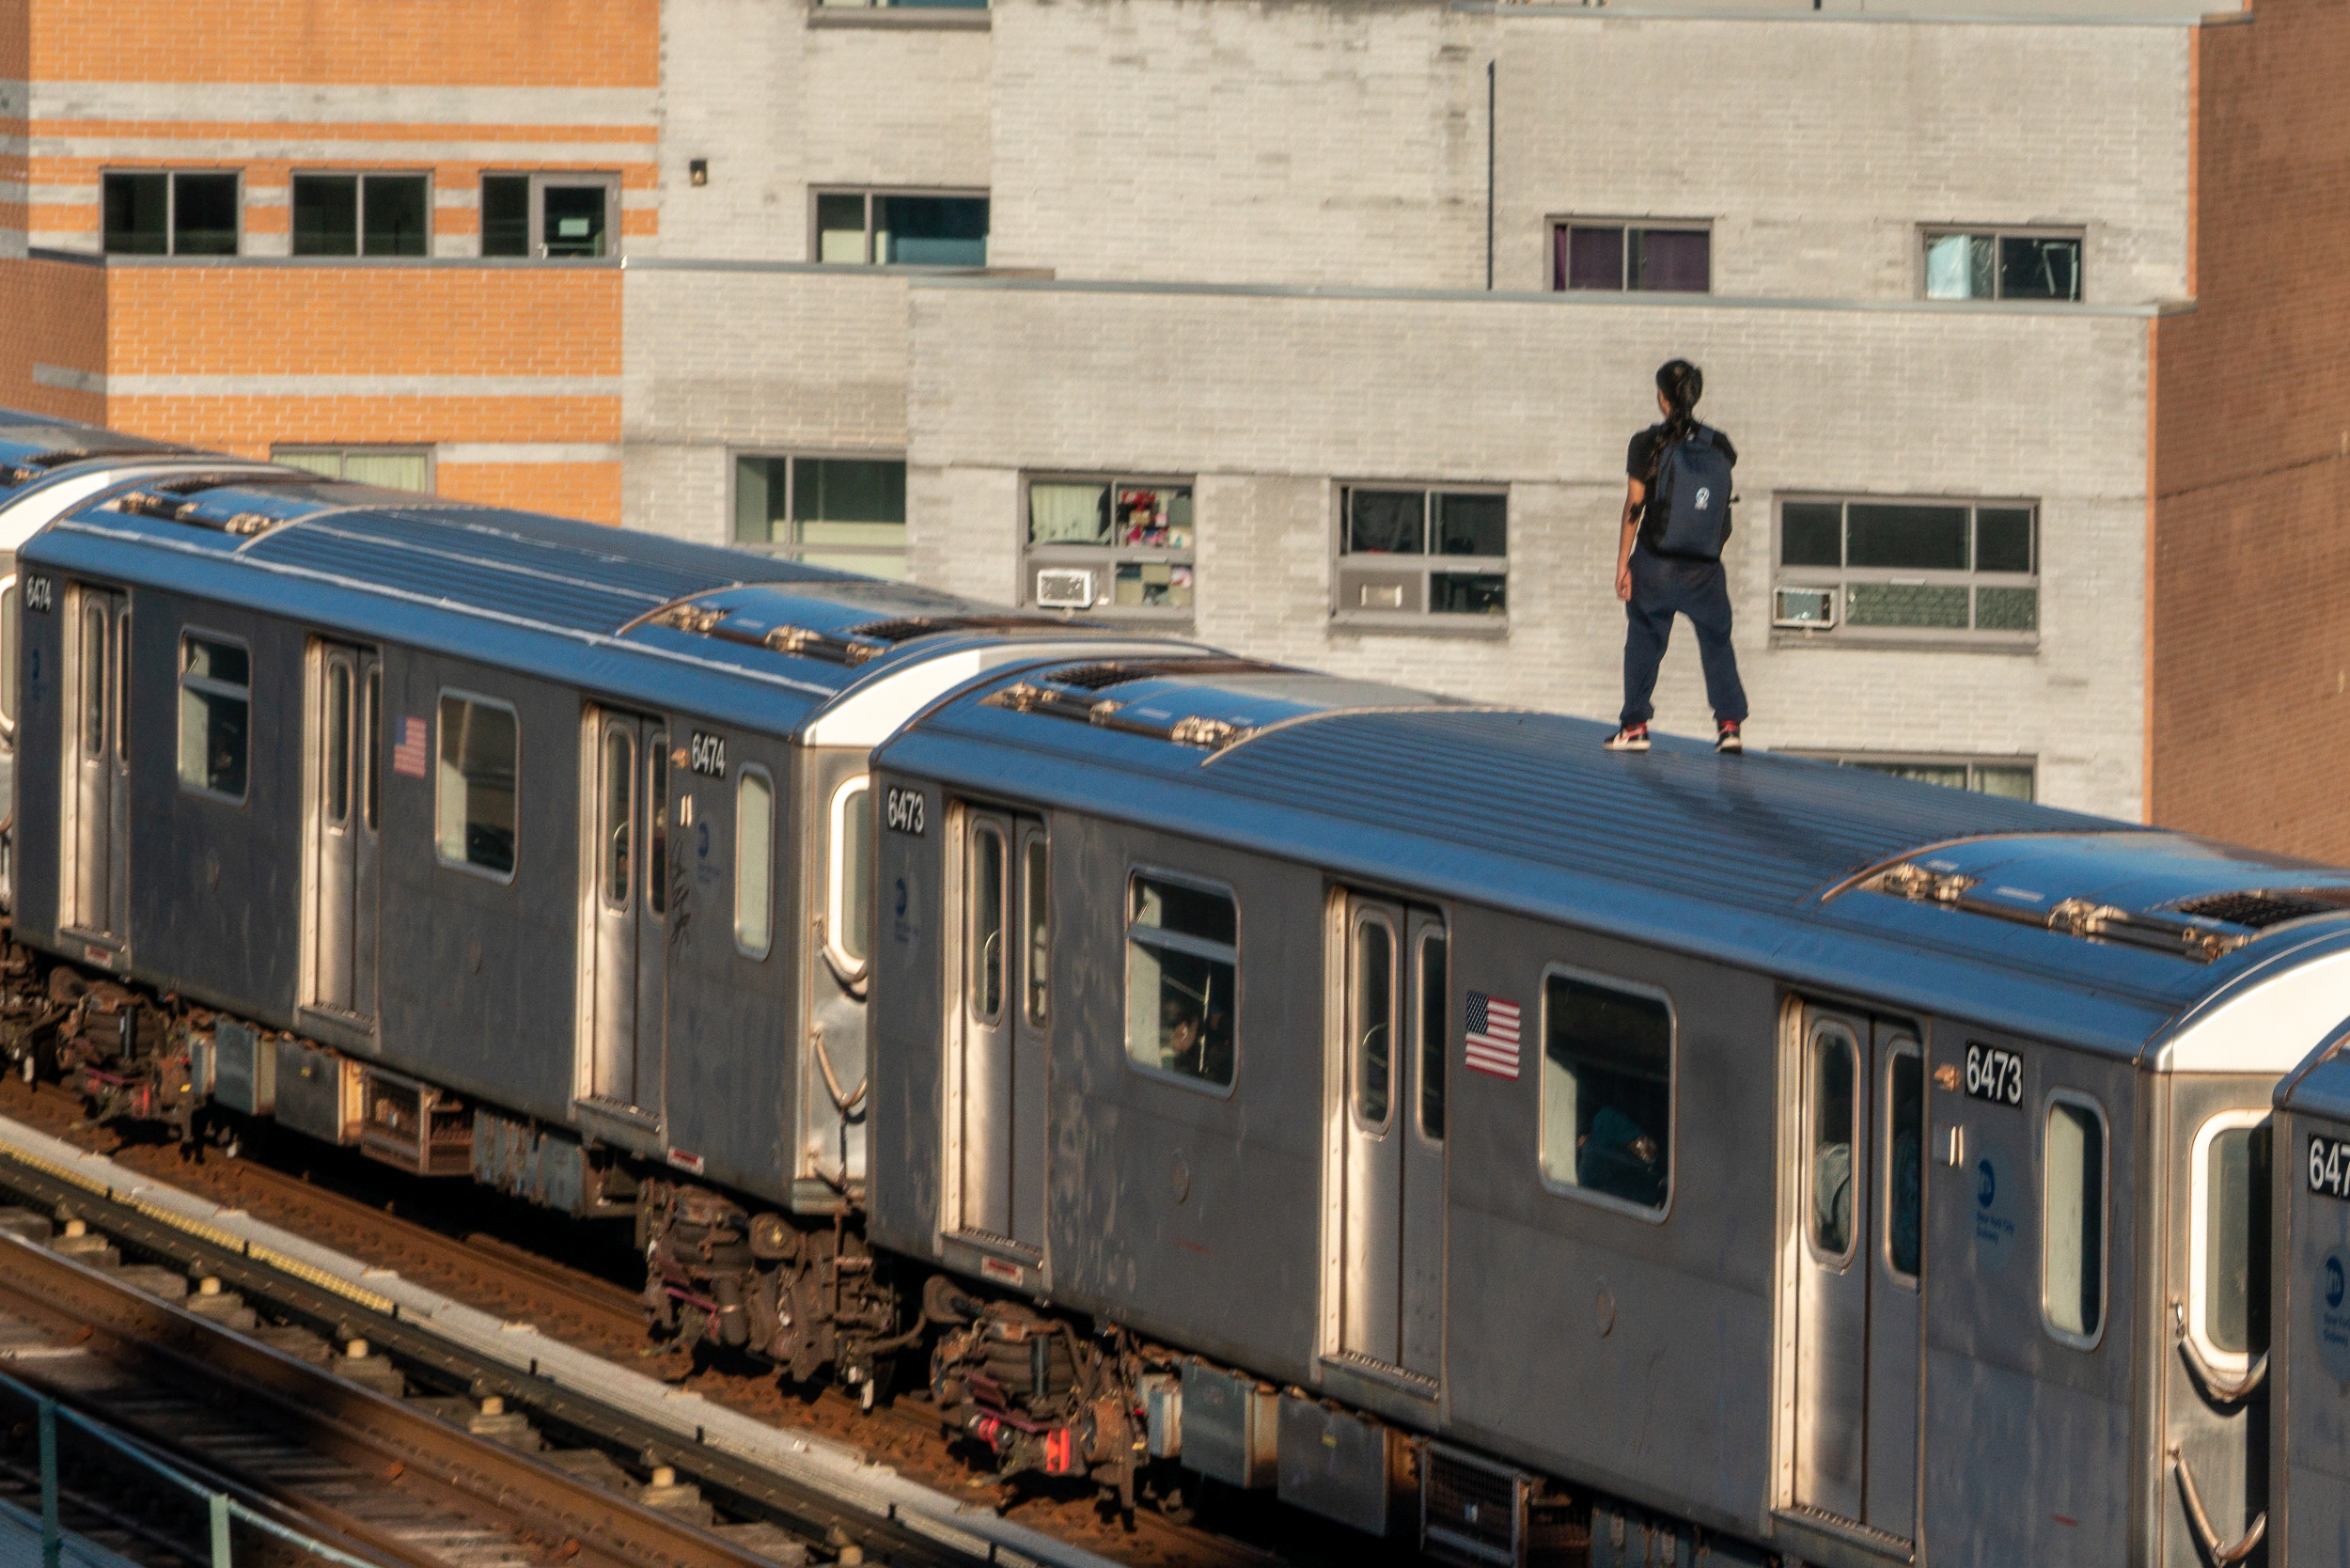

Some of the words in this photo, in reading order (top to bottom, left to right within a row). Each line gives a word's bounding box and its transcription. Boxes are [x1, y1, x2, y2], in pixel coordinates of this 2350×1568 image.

[692, 731, 726, 777] 6474
[887, 788, 925, 833] 6473
[1966, 1044, 2022, 1105] 6473
